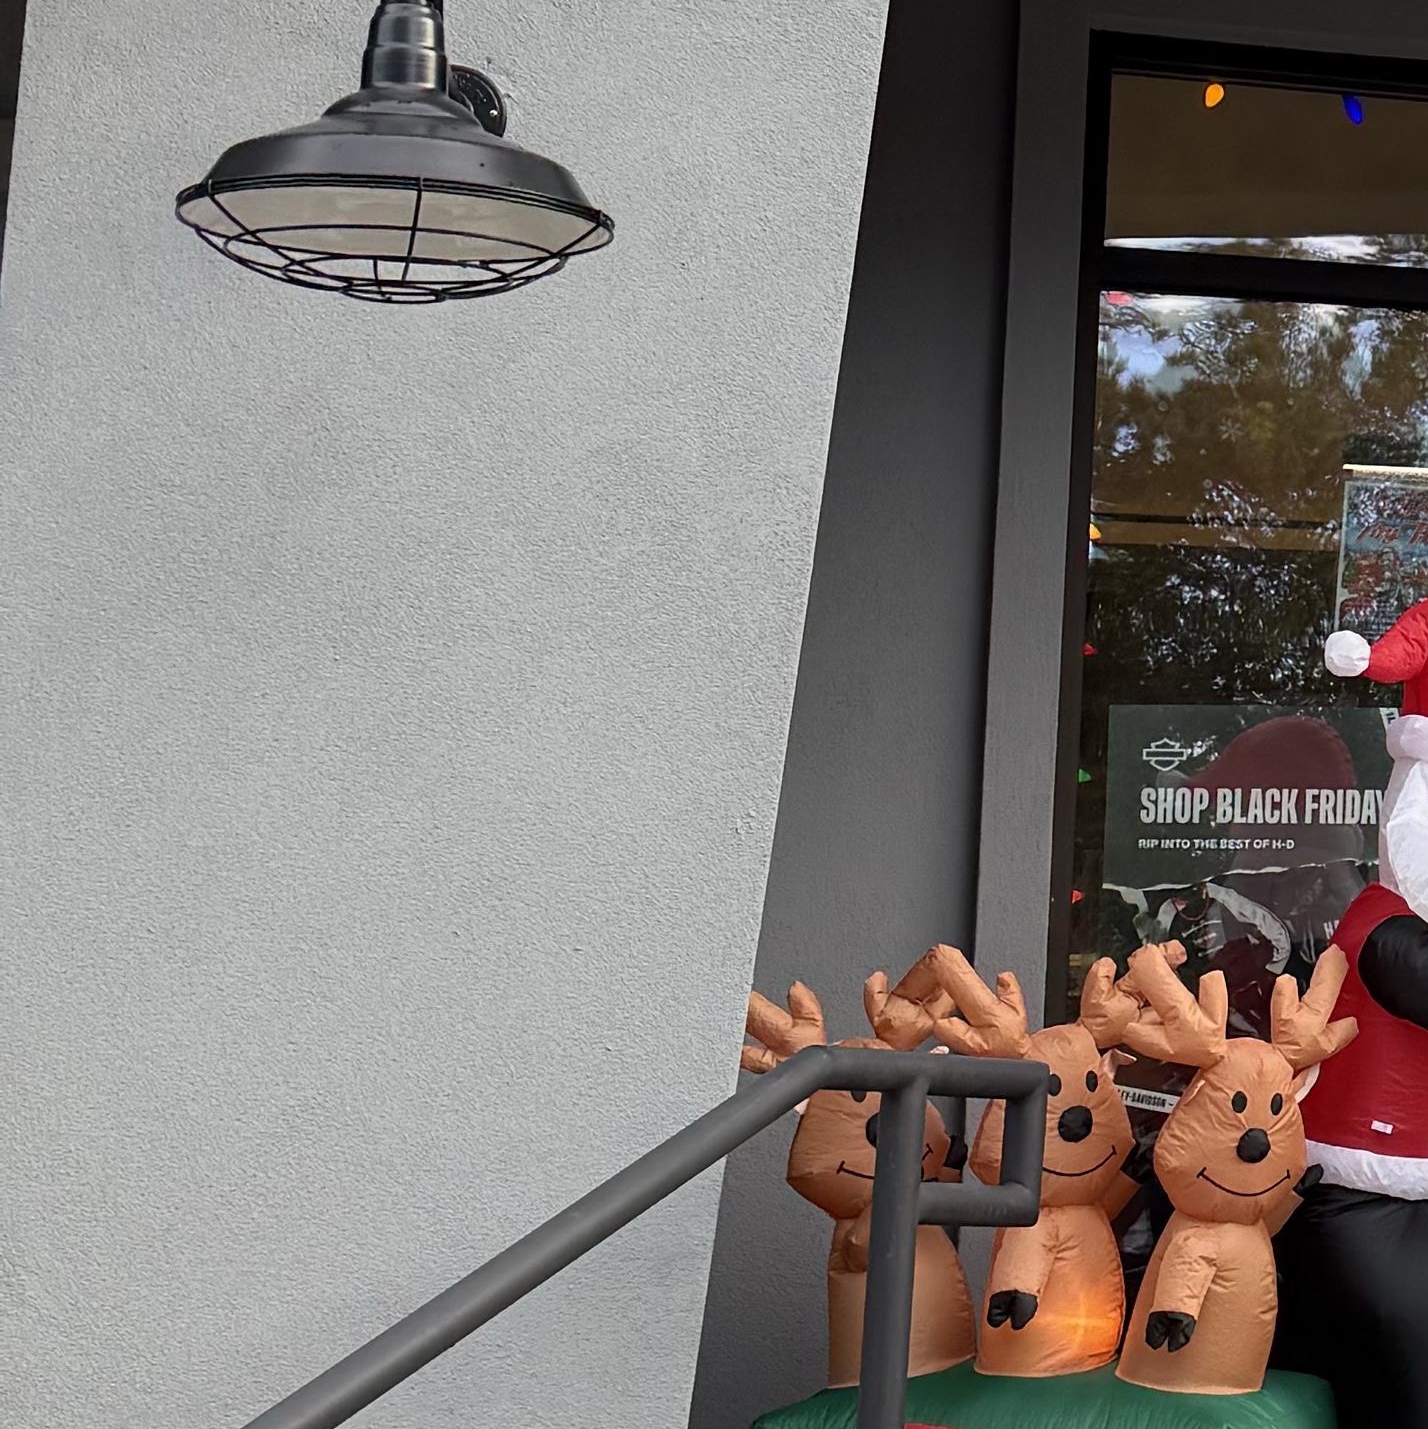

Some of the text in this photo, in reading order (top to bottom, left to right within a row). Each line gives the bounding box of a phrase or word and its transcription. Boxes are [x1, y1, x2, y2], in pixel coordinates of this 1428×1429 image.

[1140, 787, 1210, 824] SHOP
[1216, 788, 1298, 824] BLACK
[1138, 839, 1295, 849] RIP INTO THE BEST OF H-D
